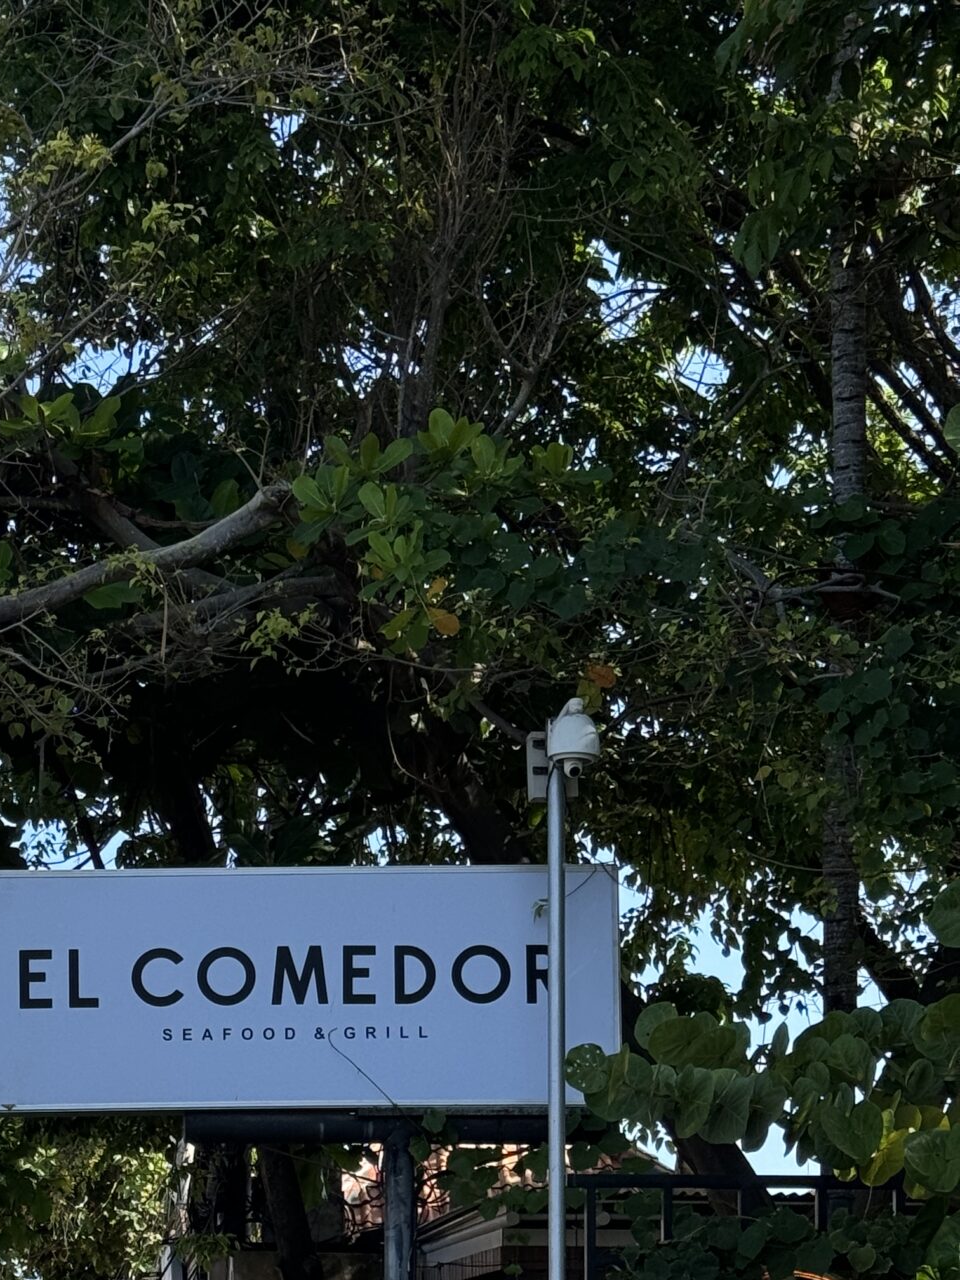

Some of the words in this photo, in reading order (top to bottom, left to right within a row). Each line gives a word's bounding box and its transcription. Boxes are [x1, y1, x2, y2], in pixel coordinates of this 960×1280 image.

[18, 948, 100, 1009] EL
[131, 944, 549, 1007] COMEDOR
[162, 1027, 297, 1042] SEAFOOD
[313, 1026, 327, 1041] &
[343, 1025, 430, 1040] GRILL
